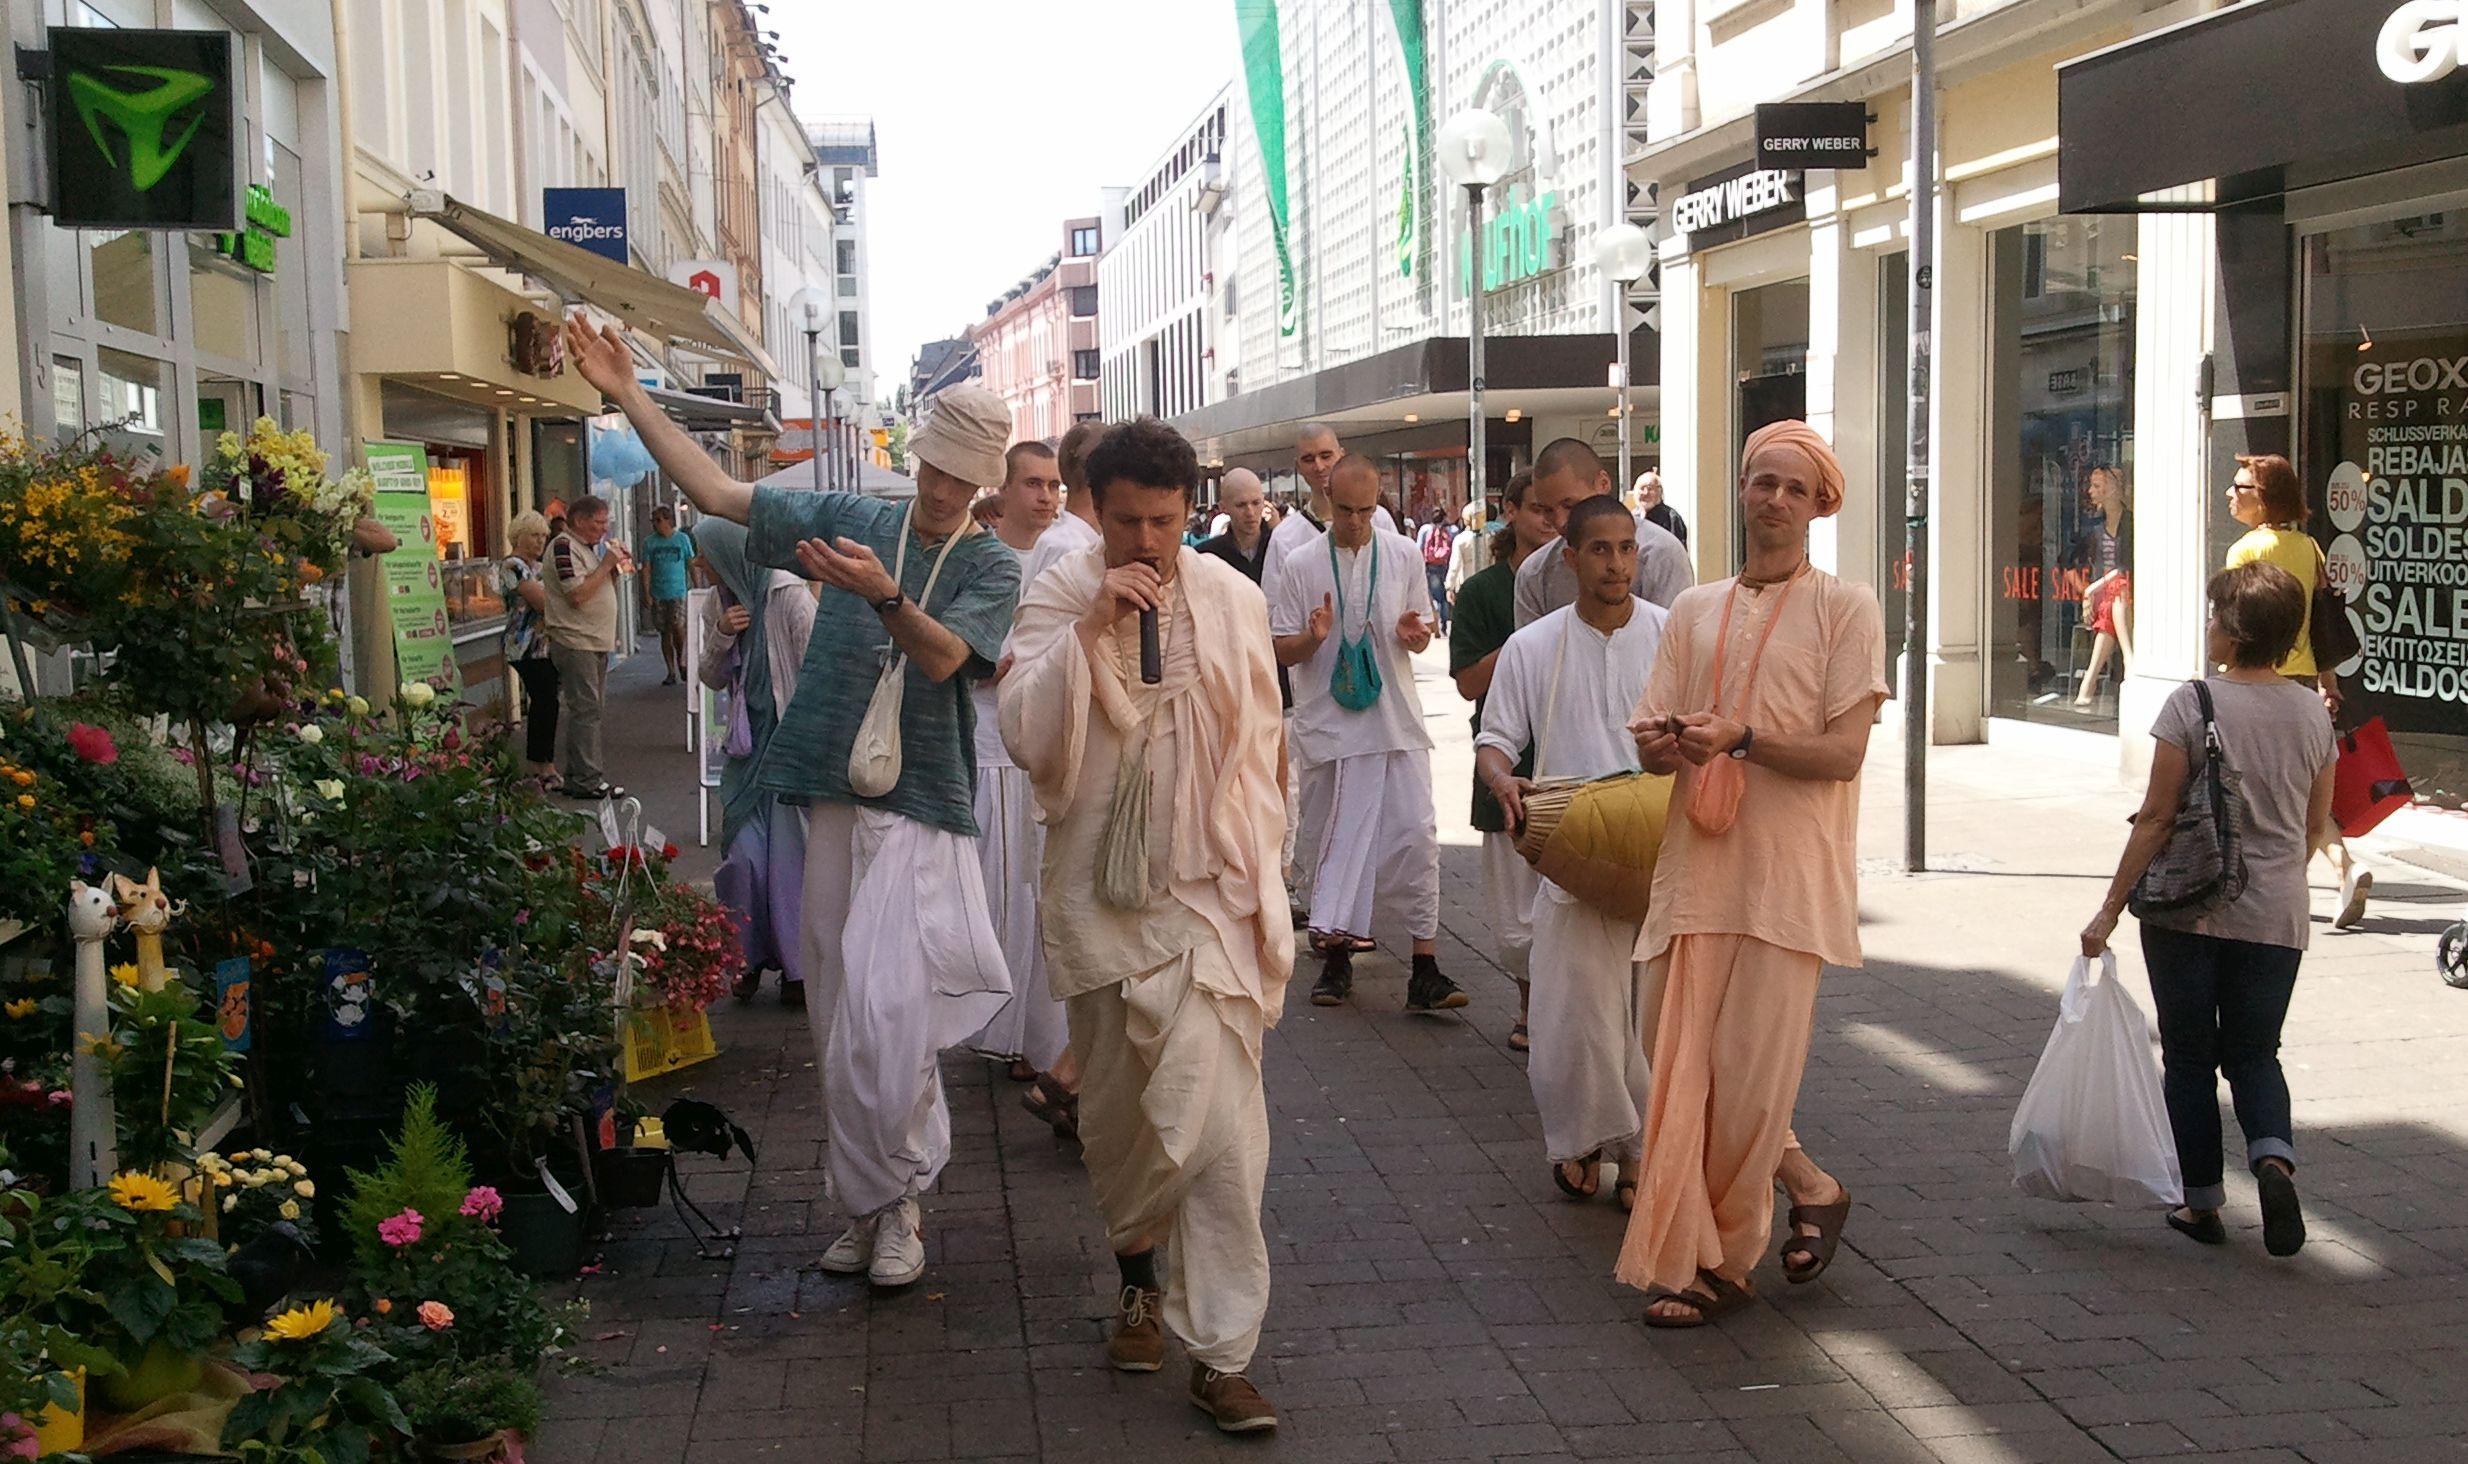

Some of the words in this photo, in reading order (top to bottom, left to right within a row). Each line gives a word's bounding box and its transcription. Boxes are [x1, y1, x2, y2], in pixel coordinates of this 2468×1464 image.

[1764, 138, 1809, 151] GERRY
[1812, 137, 1861, 150] WEBER
[1672, 182, 1724, 235] GERRY
[1725, 169, 1790, 220] WEBER
[549, 223, 624, 243] engbers
[2353, 356, 2468, 396] GEOX
[2330, 489, 2365, 512] 50%
[2003, 565, 2040, 600] SALE
[2330, 562, 2365, 585] 50%
